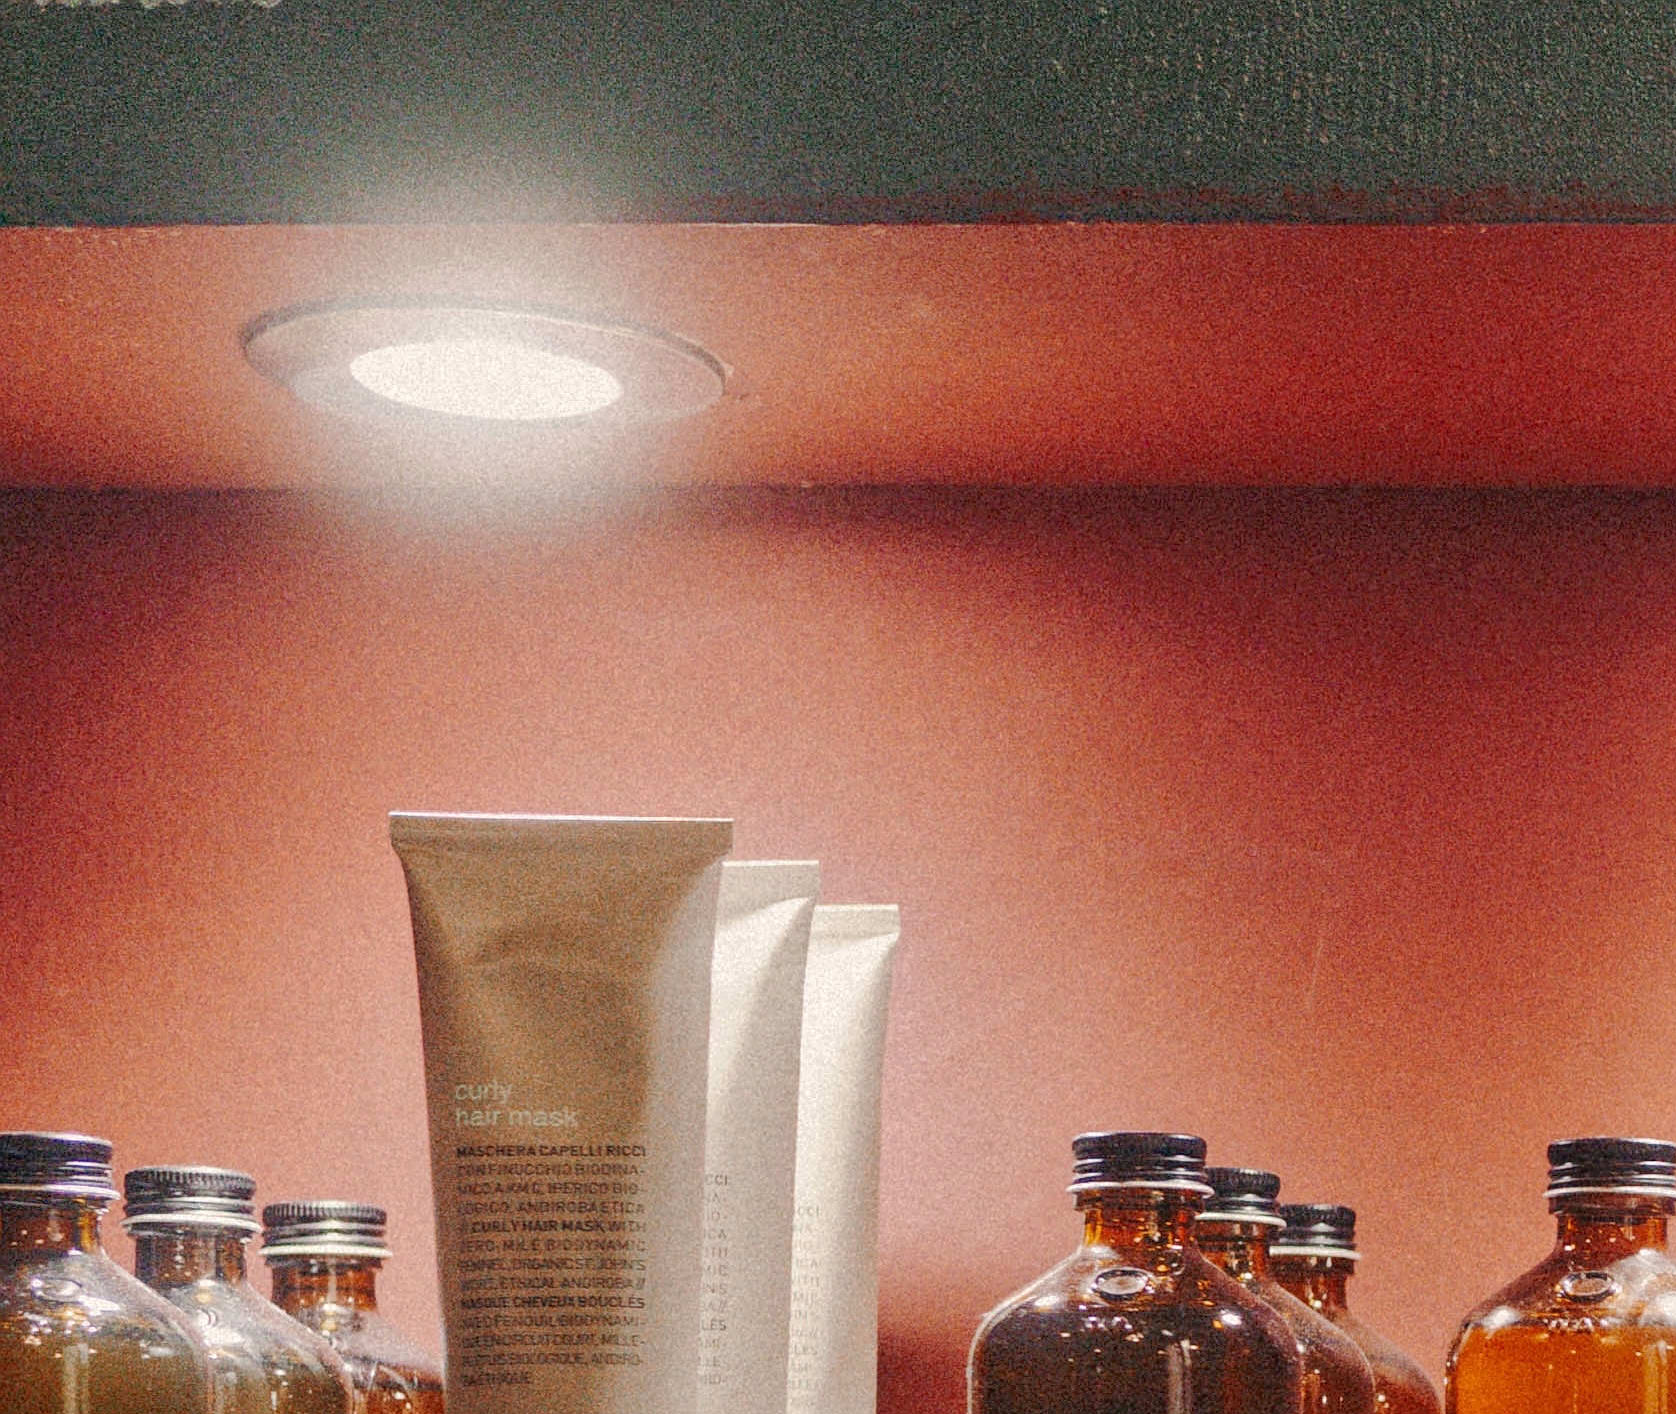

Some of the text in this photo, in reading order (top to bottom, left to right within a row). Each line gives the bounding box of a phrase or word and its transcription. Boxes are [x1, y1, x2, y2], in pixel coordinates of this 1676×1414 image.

[456, 1077, 512, 1105] curly
[456, 1105, 579, 1127] hair mask
[539, 1145, 601, 1157] CAPELLI
[606, 1145, 646, 1157] RICCI
[522, 1220, 559, 1233] HAIR
[562, 1220, 606, 1233] MASK
